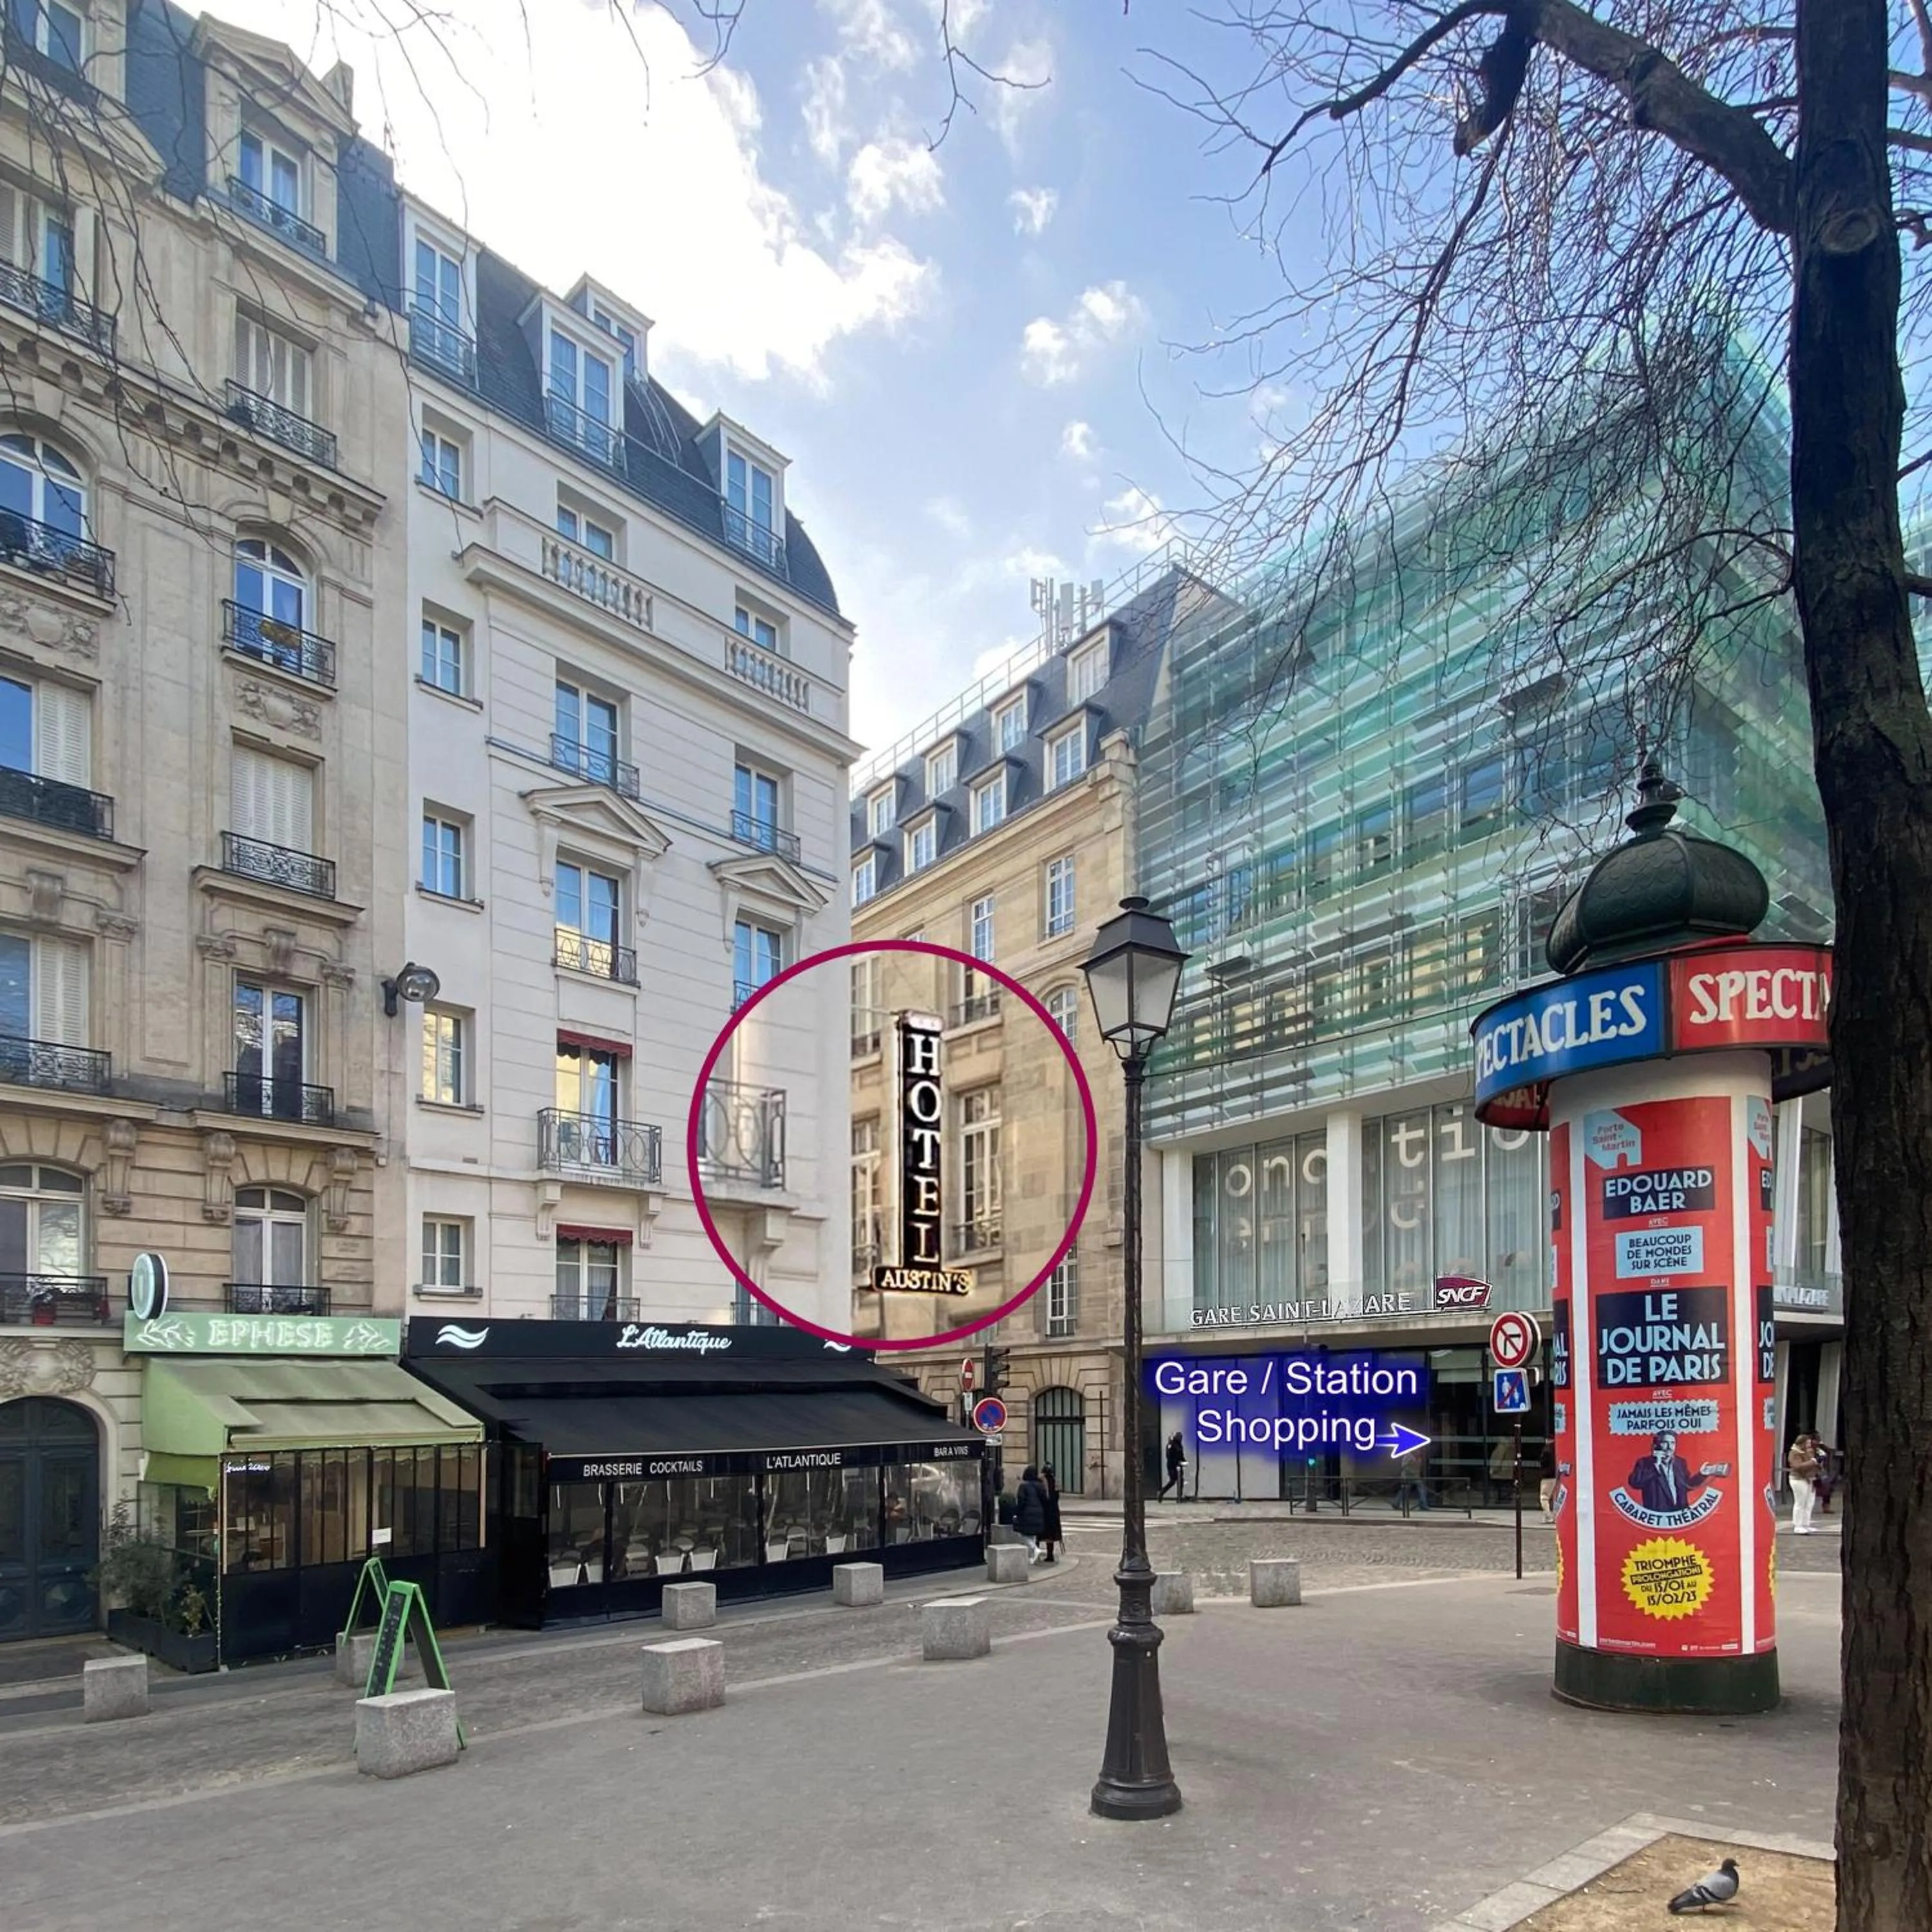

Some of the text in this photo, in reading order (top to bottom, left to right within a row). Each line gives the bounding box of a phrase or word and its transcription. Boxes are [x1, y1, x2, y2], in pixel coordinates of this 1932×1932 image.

[1475, 985, 1647, 1088] PECTACLES
[1597, 1124, 1624, 1135] Porte
[907, 1033, 942, 1264] HOTEL
[1602, 1140, 1636, 1151] Martin
[1605, 1170, 1712, 1198] EDOUARD
[1630, 1191, 1687, 1214] BAER
[1649, 1217, 1669, 1226] AVEC
[1629, 1234, 1692, 1248] BEAUCOUP
[1627, 1245, 1692, 1259] DE MONDES
[1632, 1255, 1687, 1270] SUR SCÈNE
[881, 1269, 971, 1294] AUSTIN'S
[1437, 1286, 1487, 1305] SNCF
[1189, 1292, 1413, 1327] GARE SAINT-LAZARE
[1645, 1293, 1678, 1321] LE
[208, 1320, 334, 1348] EPHESE
[616, 1323, 732, 1355] L'Atlantique
[1599, 1322, 1726, 1355] JOURNAL
[1607, 1353, 1721, 1384] DE PARIS
[1617, 1404, 1711, 1419] JAMAIS LES MÊMES
[1627, 1417, 1701, 1431] PARFOIS OUI
[934, 1447, 947, 1457] BAR
[954, 1445, 969, 1455] VINS
[583, 1460, 703, 1477] BRASSERIE COCKTAILS
[766, 1452, 841, 1469] L'ATLANTIQUE
[1615, 1492, 1662, 1526] CABARET
[1634, 1554, 1696, 1571] TRIOMPHE
[1631, 1567, 1701, 1584] PROLONGATIONS
